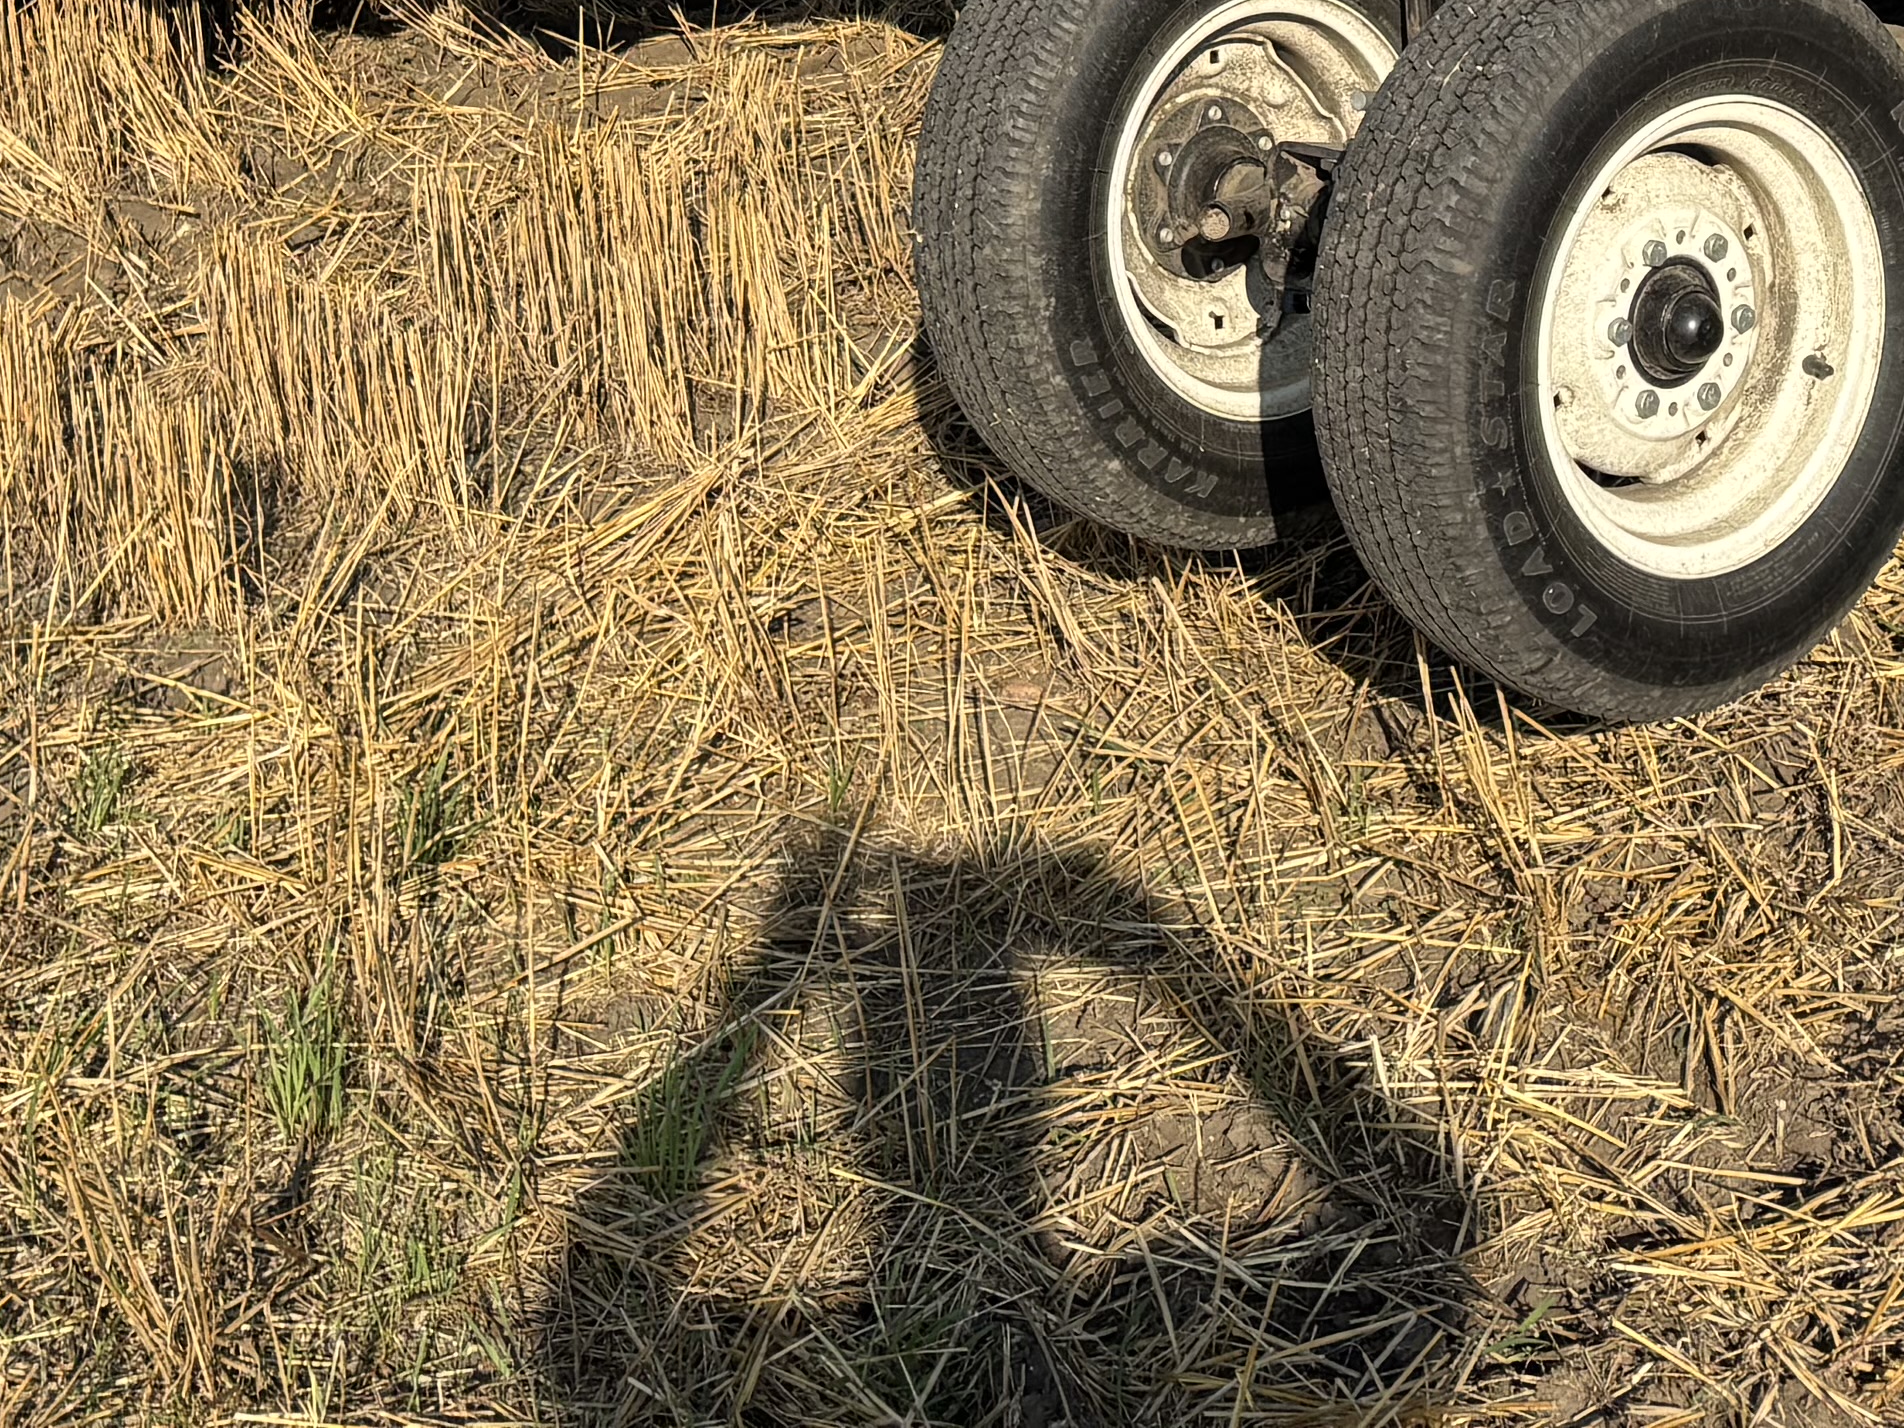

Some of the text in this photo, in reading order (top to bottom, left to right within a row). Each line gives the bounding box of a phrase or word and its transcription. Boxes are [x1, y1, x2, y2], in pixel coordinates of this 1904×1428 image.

[1069, 337, 1219, 499] KARRIER
[1479, 278, 1598, 638] LOAD STAR
